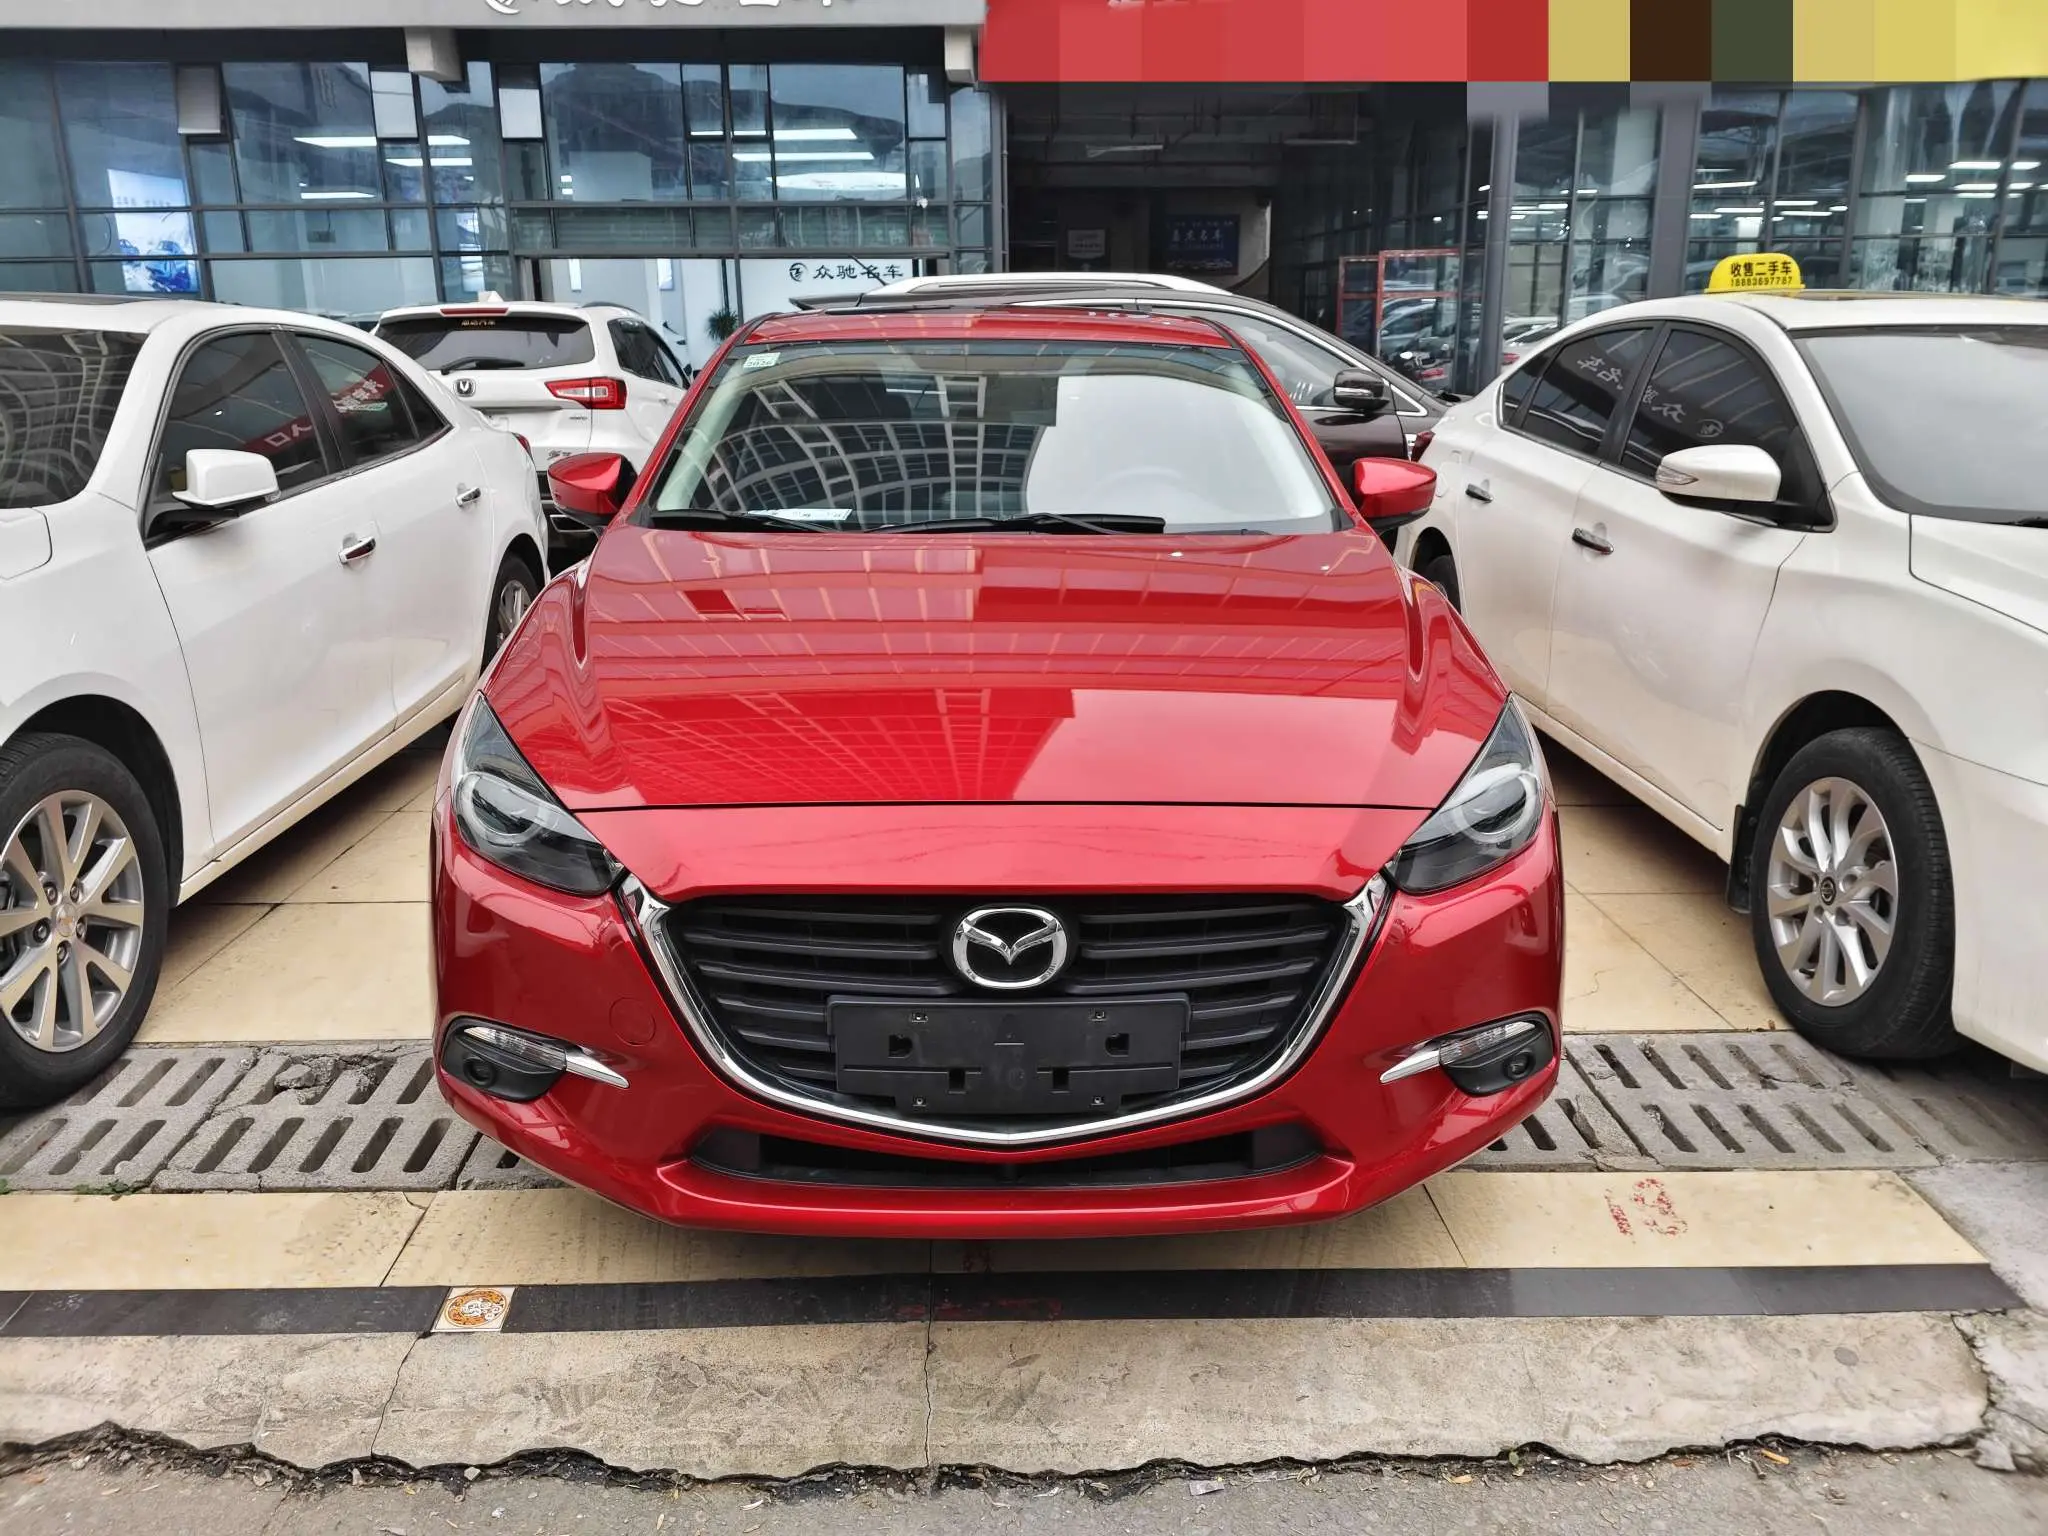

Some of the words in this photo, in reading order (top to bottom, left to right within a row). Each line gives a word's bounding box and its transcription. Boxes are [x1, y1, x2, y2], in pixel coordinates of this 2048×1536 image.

[813, 264, 903, 280] 众驰名车
[1730, 260, 1792, 278] 收售二手车
